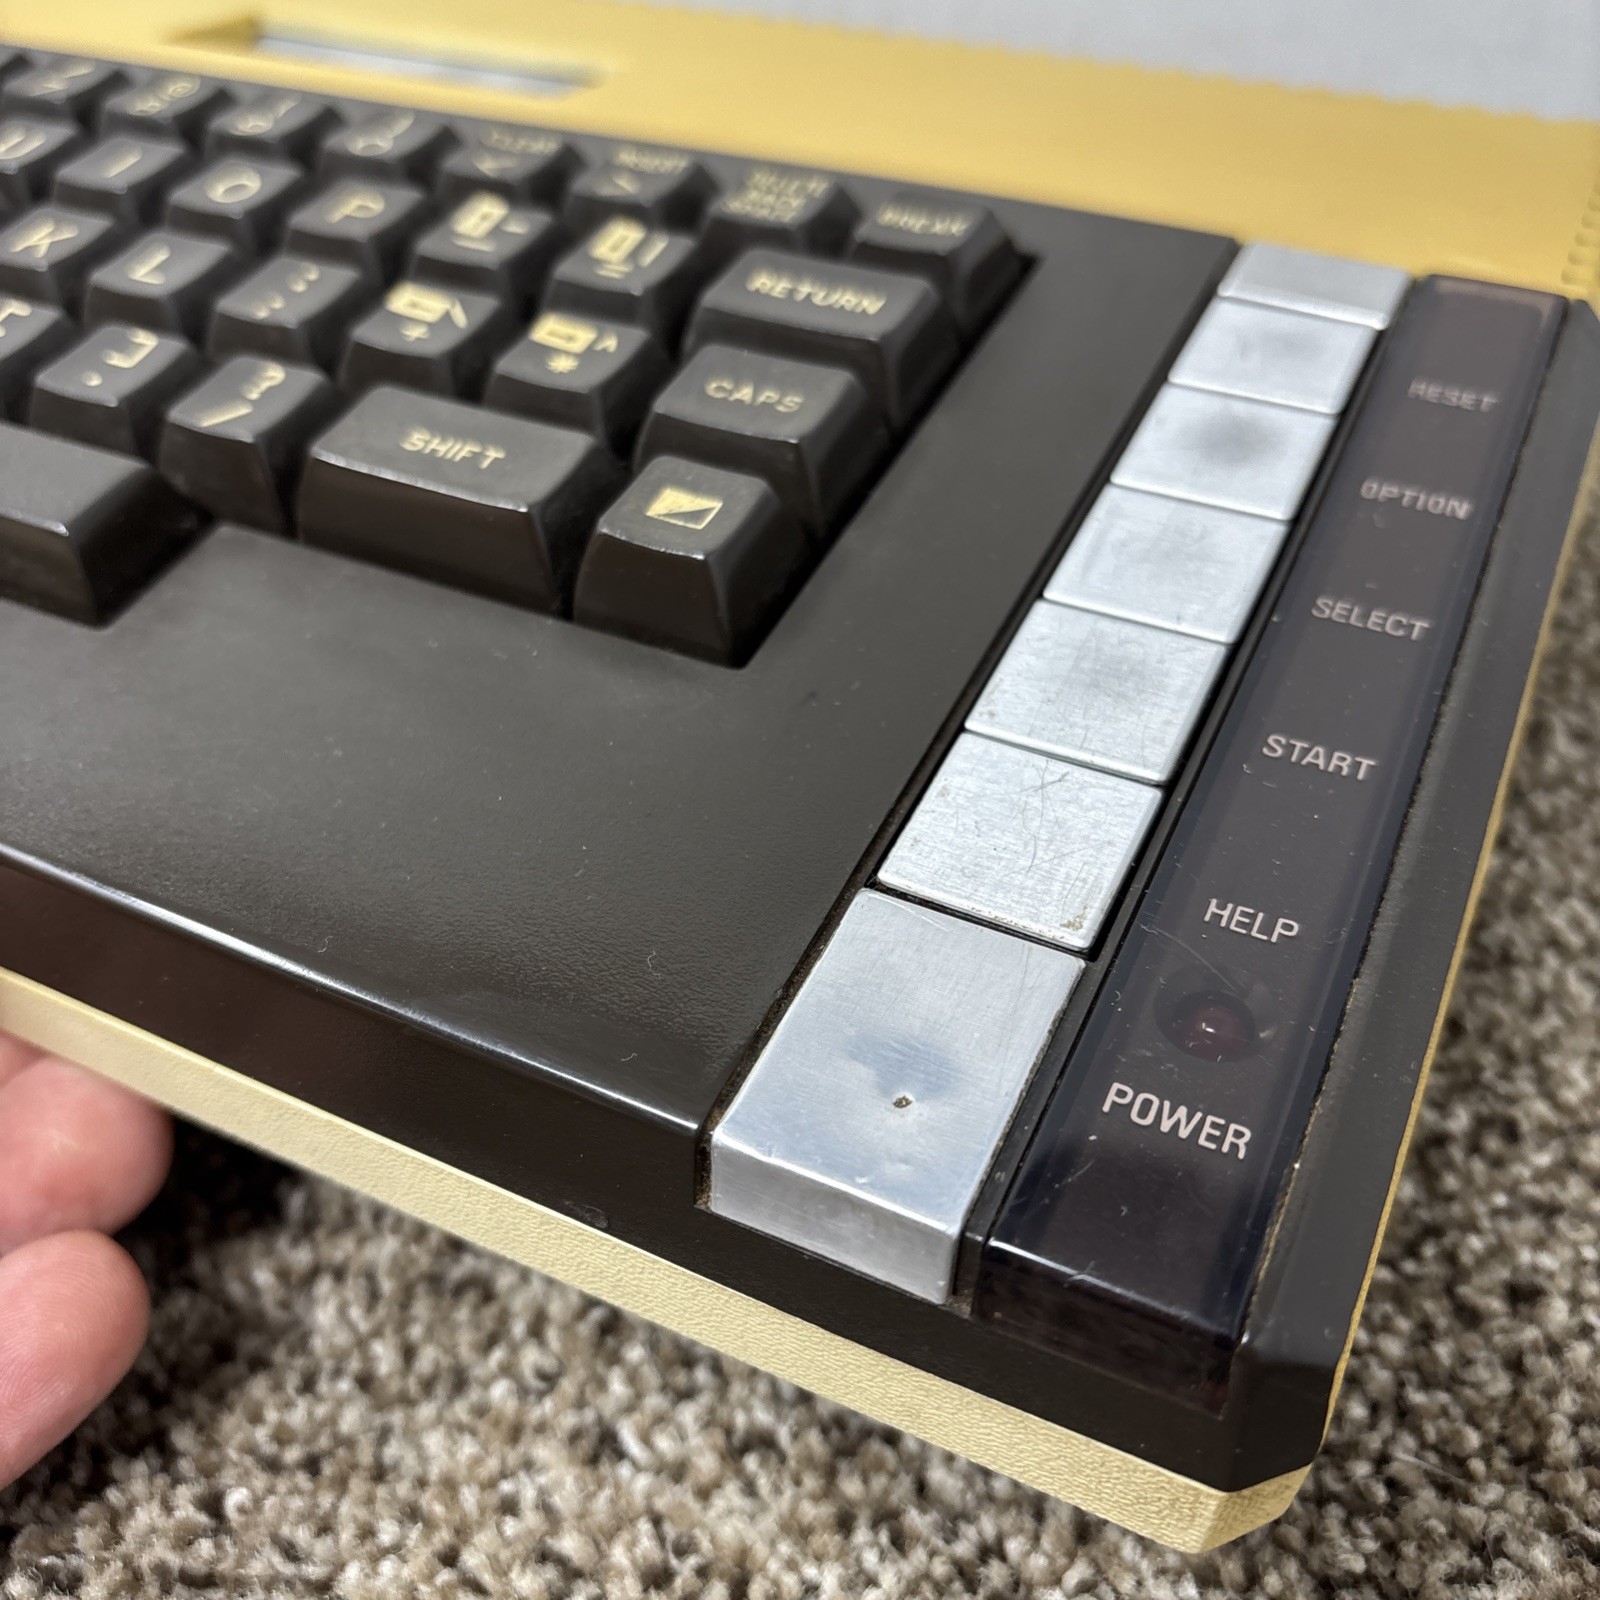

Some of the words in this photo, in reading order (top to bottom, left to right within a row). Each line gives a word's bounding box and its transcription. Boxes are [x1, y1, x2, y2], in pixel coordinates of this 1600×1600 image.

[328, 187, 385, 224] P
[9, 216, 80, 258] K
[127, 244, 171, 285] L
[747, 272, 886, 318] RETURN
[704, 377, 804, 415] CAPS
[1407, 376, 1499, 413] RESET
[398, 427, 507, 471] SHIFT
[1359, 477, 1473, 521] OPTION
[1310, 596, 1431, 642] SELECT
[1261, 734, 1377, 782] START
[1203, 898, 1300, 944] HELP
[1101, 1081, 1252, 1160] POWER
